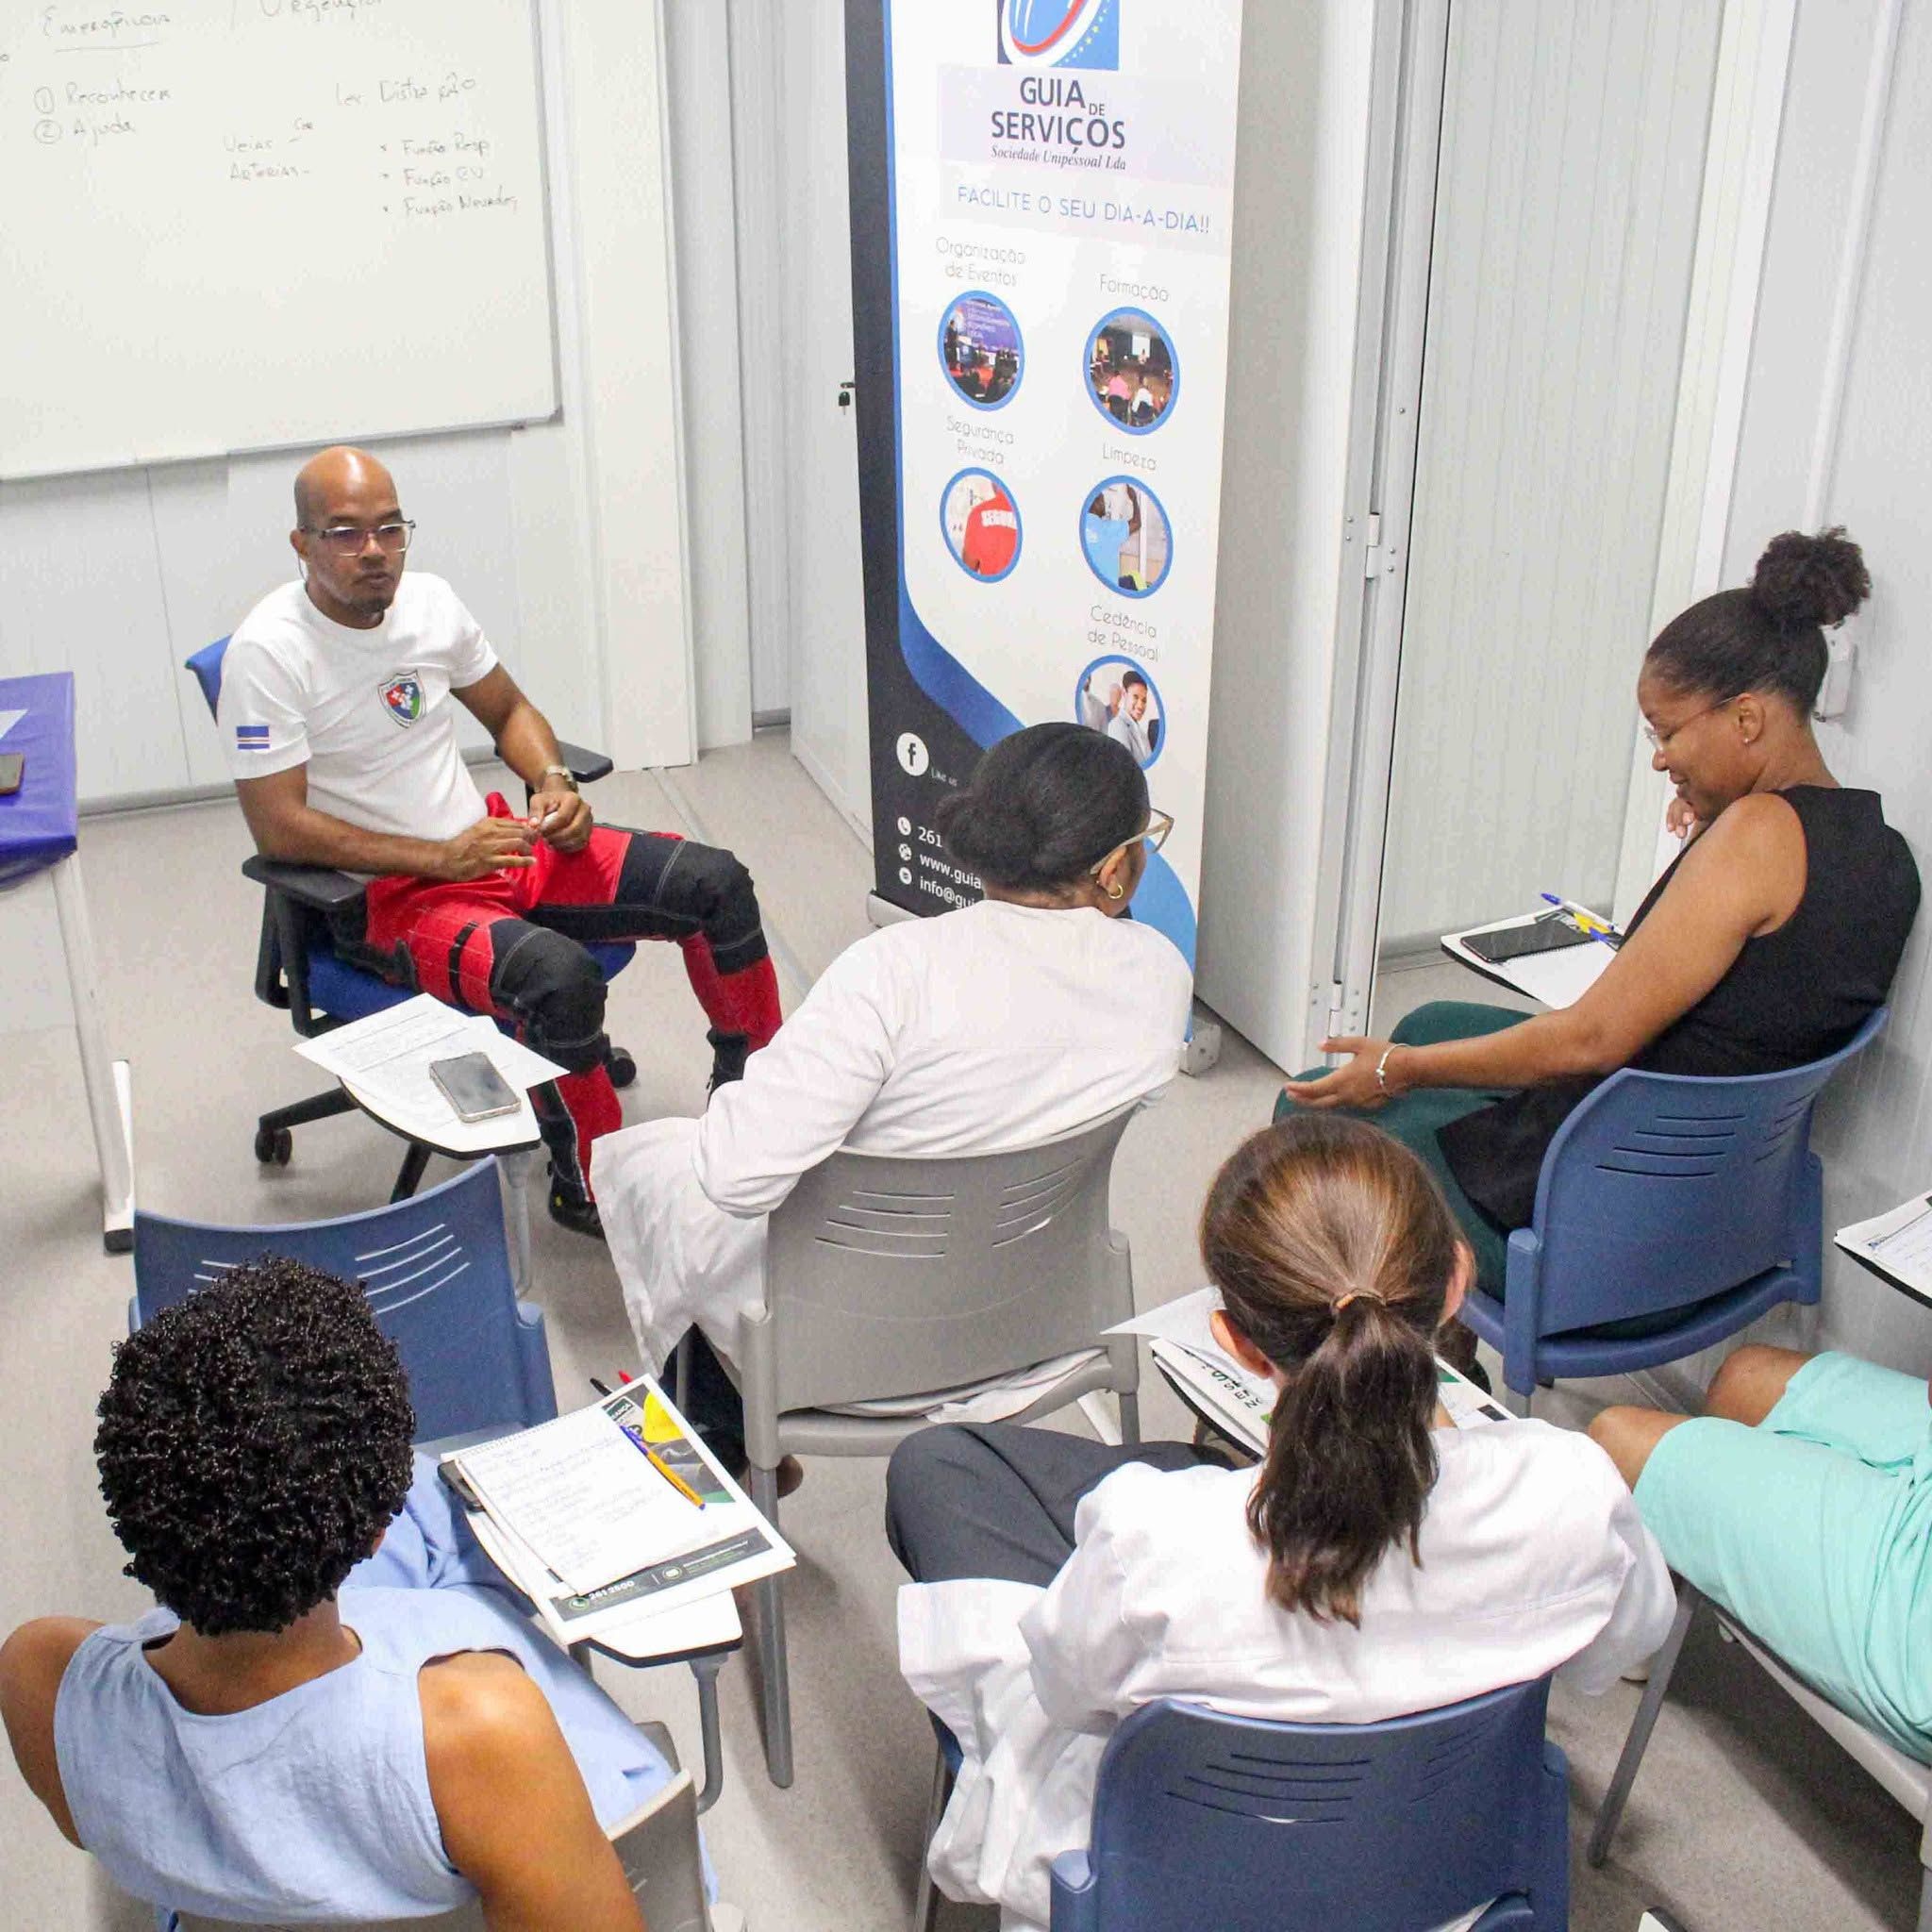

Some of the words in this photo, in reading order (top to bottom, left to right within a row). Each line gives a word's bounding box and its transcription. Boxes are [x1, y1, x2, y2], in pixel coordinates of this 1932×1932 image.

[1020, 76, 1086, 109] GUIA
[1089, 103, 1105, 116] DE
[991, 110, 1126, 154] SERVIÇOS
[991, 144, 1040, 162] Sociedade
[1106, 155, 1126, 170] Lda
[958, 186, 1030, 211] FACILITE
[1038, 192, 1052, 213] O
[1059, 193, 1096, 218] SEU
[1105, 203, 1210, 234] DIA-A-DIA!!
[936, 237, 1025, 264] Organização
[945, 262, 963, 278] de
[968, 264, 1017, 287] Eventos
[1100, 274, 1170, 302] Formação
[946, 416, 1014, 445] Segurança
[958, 439, 1004, 464] Privada
[1103, 442, 1158, 471] Limpeza
[1090, 604, 1157, 639] Cedência
[1088, 628, 1106, 646] de
[1112, 631, 1160, 662] Pessoal
[918, 826, 943, 848] 261
[920, 854, 982, 890] www.guia
